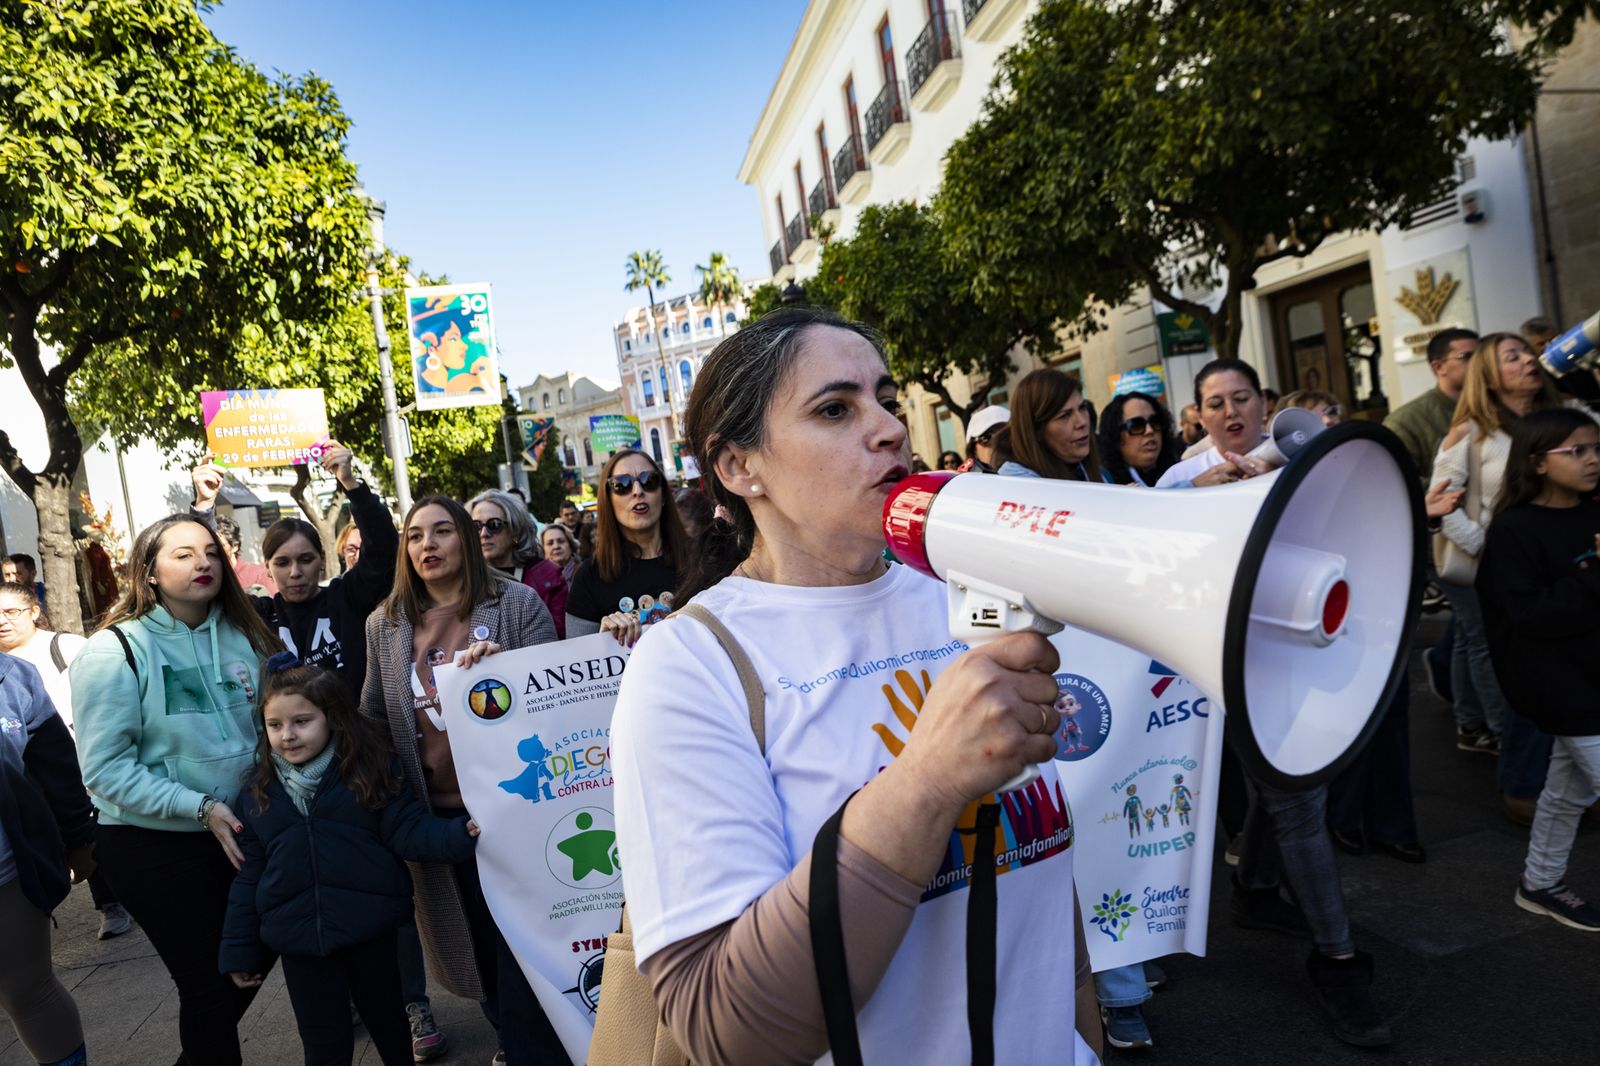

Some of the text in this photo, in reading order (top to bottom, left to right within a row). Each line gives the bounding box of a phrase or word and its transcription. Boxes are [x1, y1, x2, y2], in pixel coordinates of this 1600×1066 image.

[461, 294, 487, 316] 30
[219, 396, 245, 411] DÍA
[249, 410, 287, 423] de las
[246, 437, 295, 450] RARAS:
[223, 446, 322, 464] 29 de FEBRERO
[523, 653, 631, 695] ANSED
[525, 680, 622, 706] ASOCIACIÓN NACIONAL SÍ
[527, 702, 555, 714] EHLERS
[559, 694, 589, 706] DANLOS
[596, 688, 620, 699] HIPER
[1080, 681, 1093, 693] DE
[1092, 690, 1104, 704] UN
[1098, 704, 1109, 735] X-MEN
[551, 746, 611, 777] DIEG
[557, 779, 600, 797] CONTRA
[549, 902, 603, 920] PRADER-WILLI
[552, 892, 601, 911] ASOCIACIÓN
